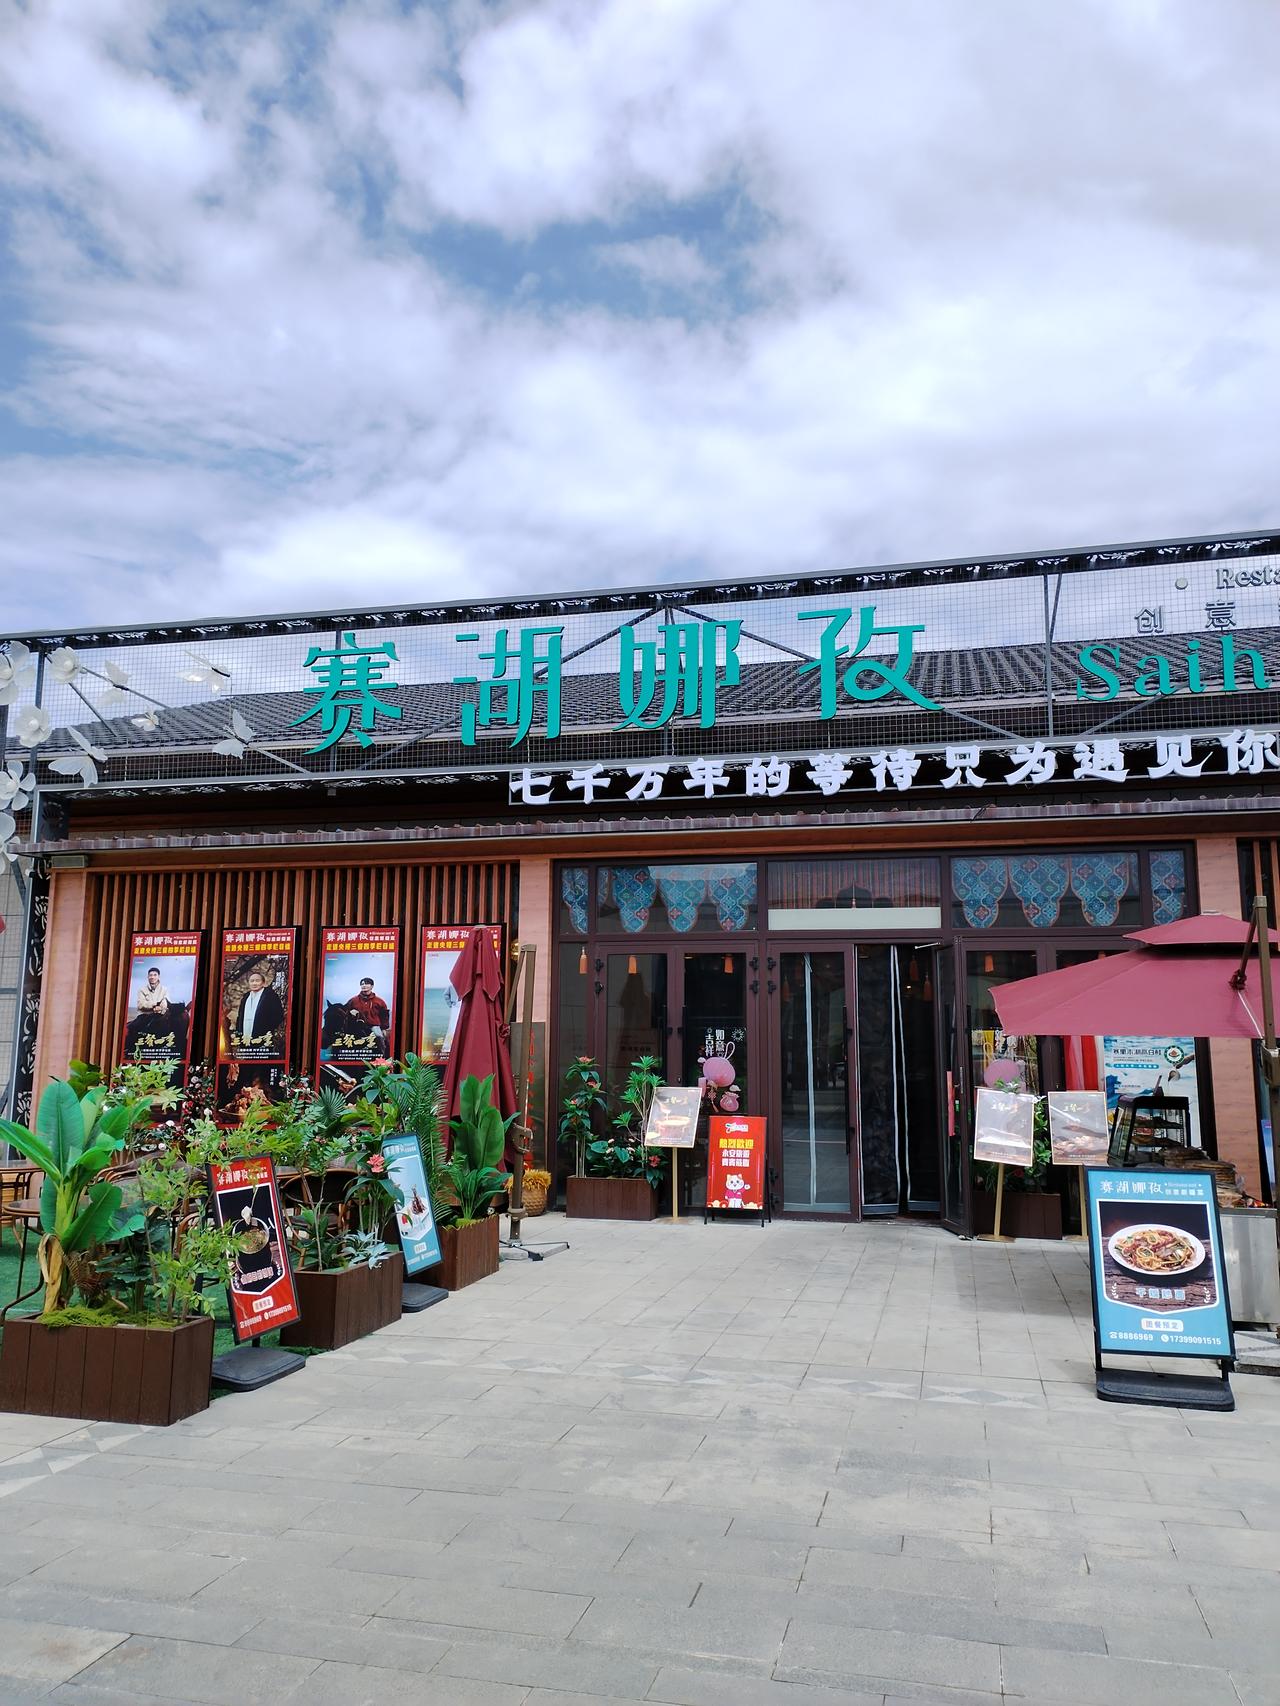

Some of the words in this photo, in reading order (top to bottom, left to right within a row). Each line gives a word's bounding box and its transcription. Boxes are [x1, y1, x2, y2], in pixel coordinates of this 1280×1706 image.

[1134, 599, 1280, 633] 创意
[287, 606, 945, 755] 赛湖娜孜
[1076, 634, 1273, 701] Saih
[510, 729, 1280, 806] 七千万年的等待只为遇见你
